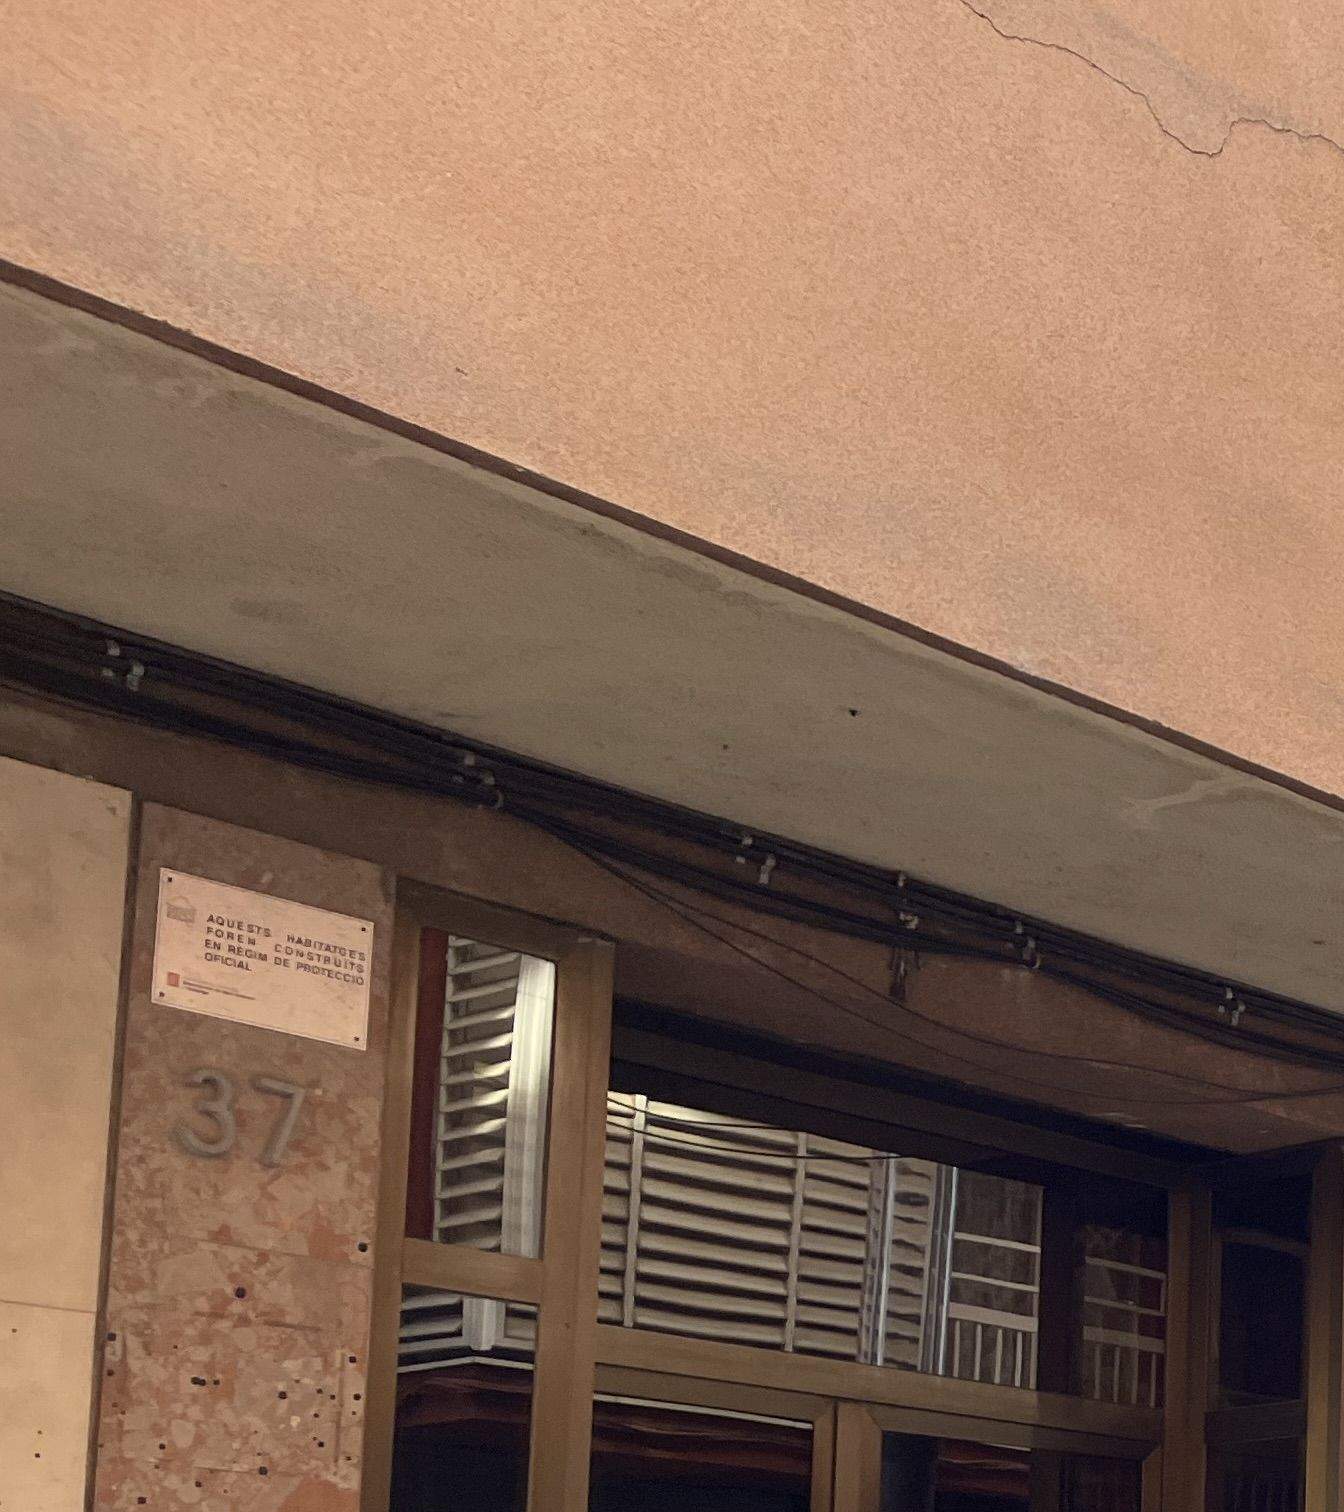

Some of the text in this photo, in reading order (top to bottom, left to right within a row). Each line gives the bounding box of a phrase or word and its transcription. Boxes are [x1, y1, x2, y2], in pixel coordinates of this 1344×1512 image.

[206, 926, 256, 946] FOREN
[206, 913, 272, 938] AQUESTS
[286, 934, 366, 962] HABITATGES
[204, 939, 221, 951] EN
[273, 956, 291, 968] DE
[204, 952, 252, 971] OFICIAL
[174, 1076, 307, 1165] 37
